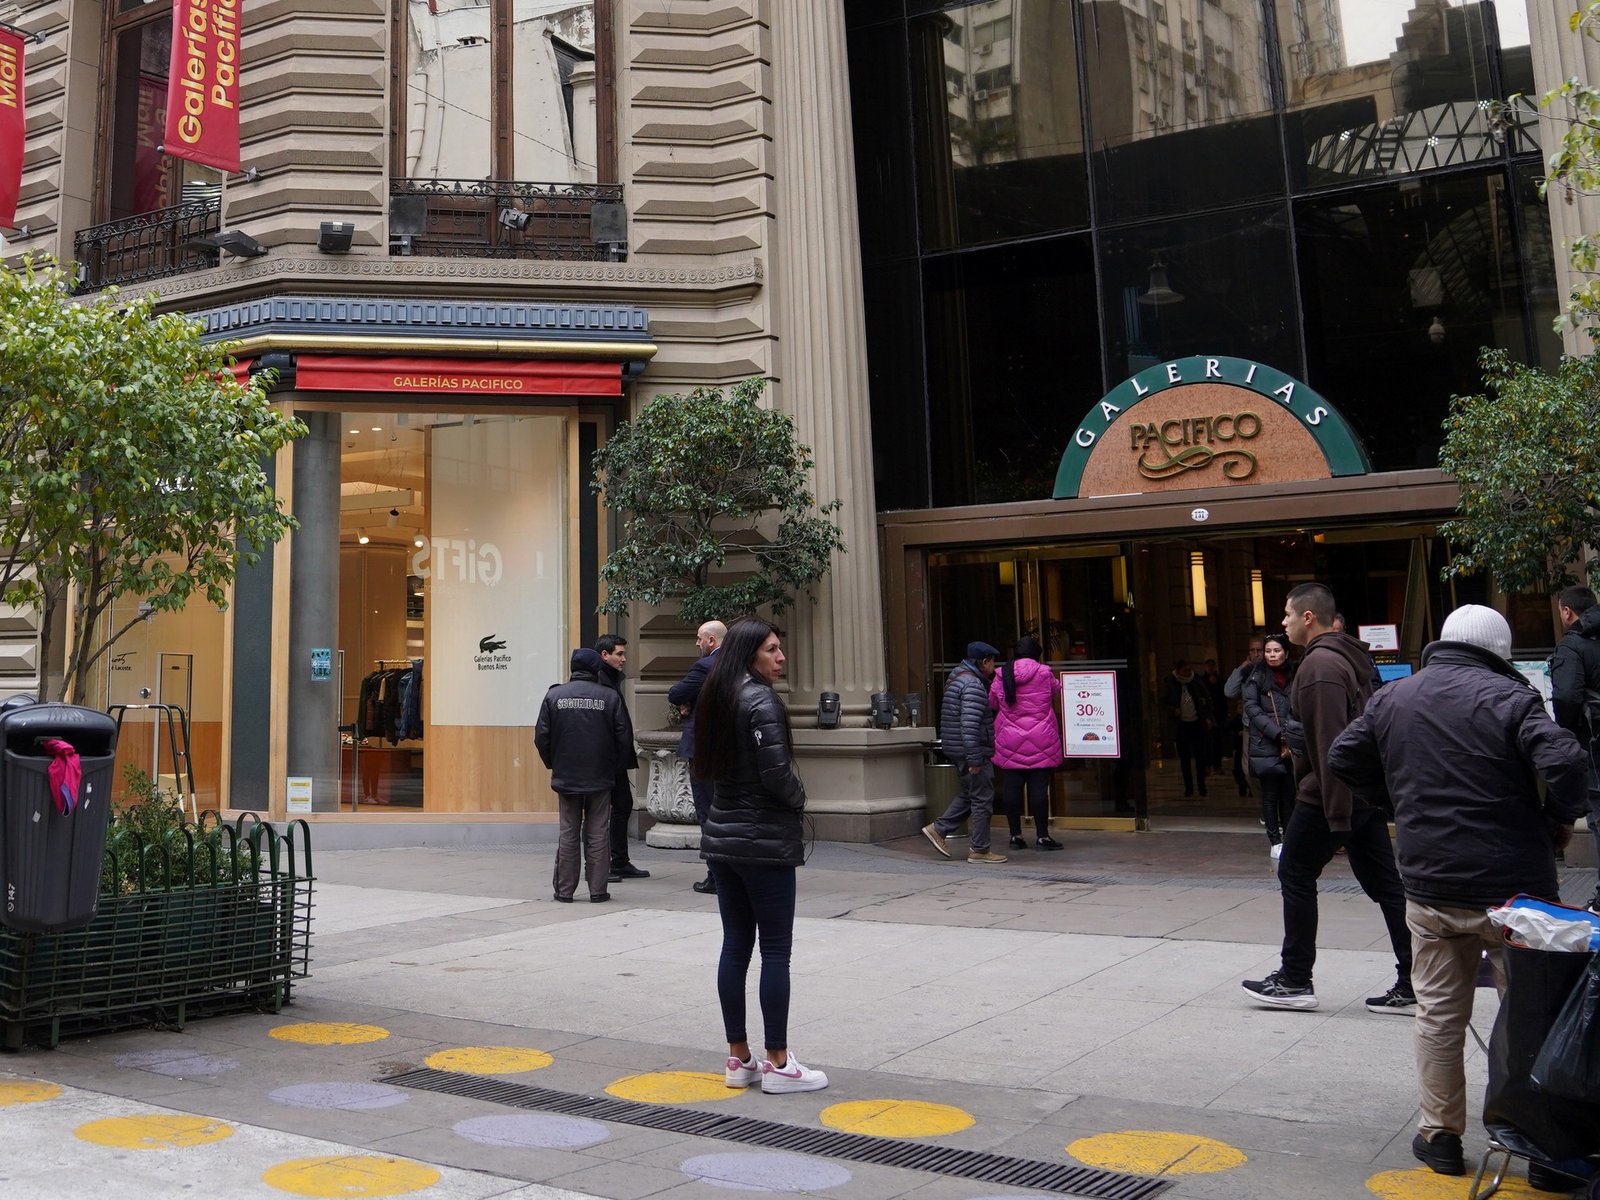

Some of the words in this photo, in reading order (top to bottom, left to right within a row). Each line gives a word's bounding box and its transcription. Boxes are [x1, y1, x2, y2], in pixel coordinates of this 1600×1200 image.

[0, 43, 17, 108] Mall
[393, 376, 459, 389] GALERÍAS
[462, 379, 524, 390] PACIFICO
[1075, 358, 1329, 448] GALERIAS
[1129, 411, 1263, 453] PACIFICO
[557, 698, 605, 710] SEGURIDAD
[1076, 704, 1105, 716] 30%
[8, 883, 16, 901] 147
